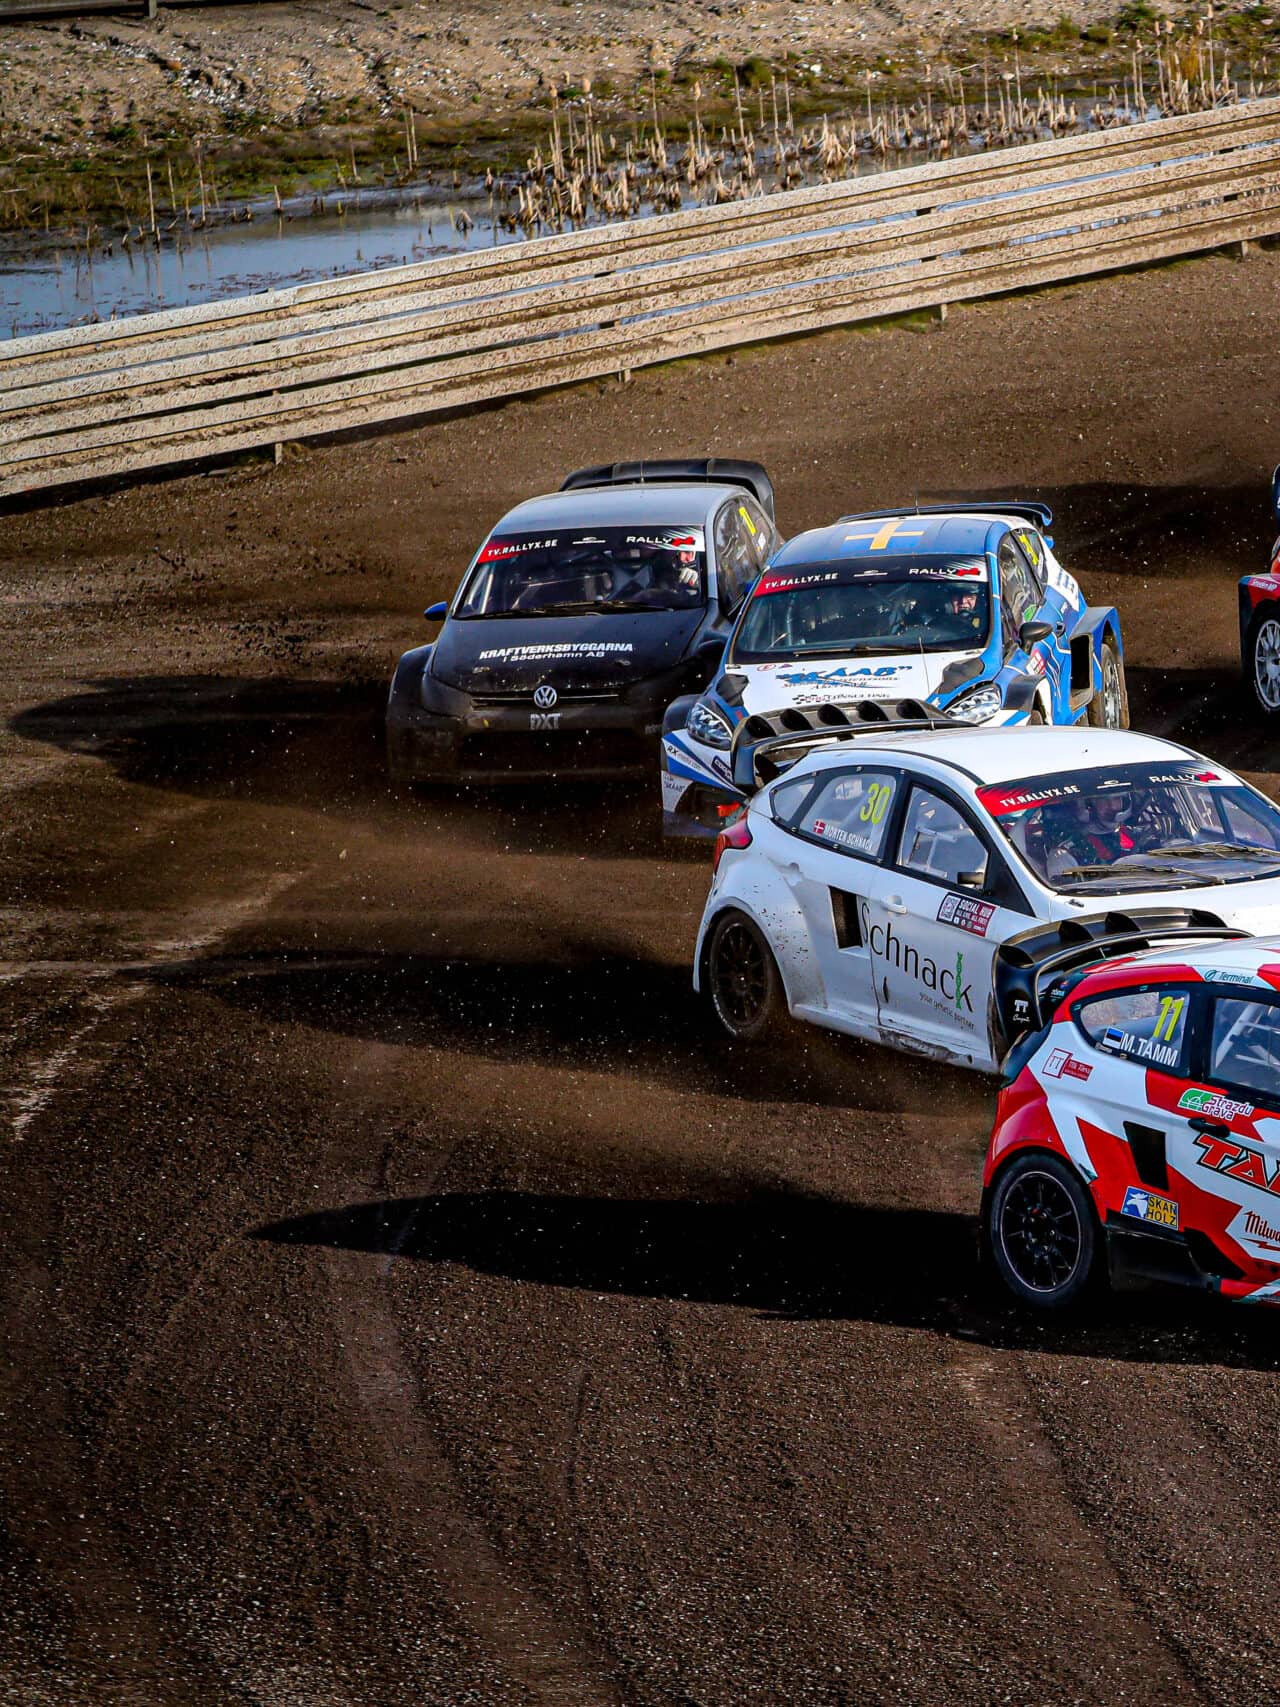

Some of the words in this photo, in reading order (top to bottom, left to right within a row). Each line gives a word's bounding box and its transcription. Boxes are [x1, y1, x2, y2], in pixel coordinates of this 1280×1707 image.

[479, 643, 633, 660] KRAFTVERKSBYGGARNA
[860, 782, 891, 825] 30
[999, 784, 1081, 807] TV.RALLYX.SE
[861, 901, 974, 1013] Schnack
[1218, 971, 1254, 984] Terminal
[1152, 996, 1185, 1042] 11
[1120, 1033, 1179, 1068] M.TAMM
[1201, 1103, 1235, 1121] Grava
[1210, 1094, 1255, 1116] Strazdu
[1148, 1195, 1177, 1216] SKAN
[1145, 1208, 1177, 1226] HOLZ
